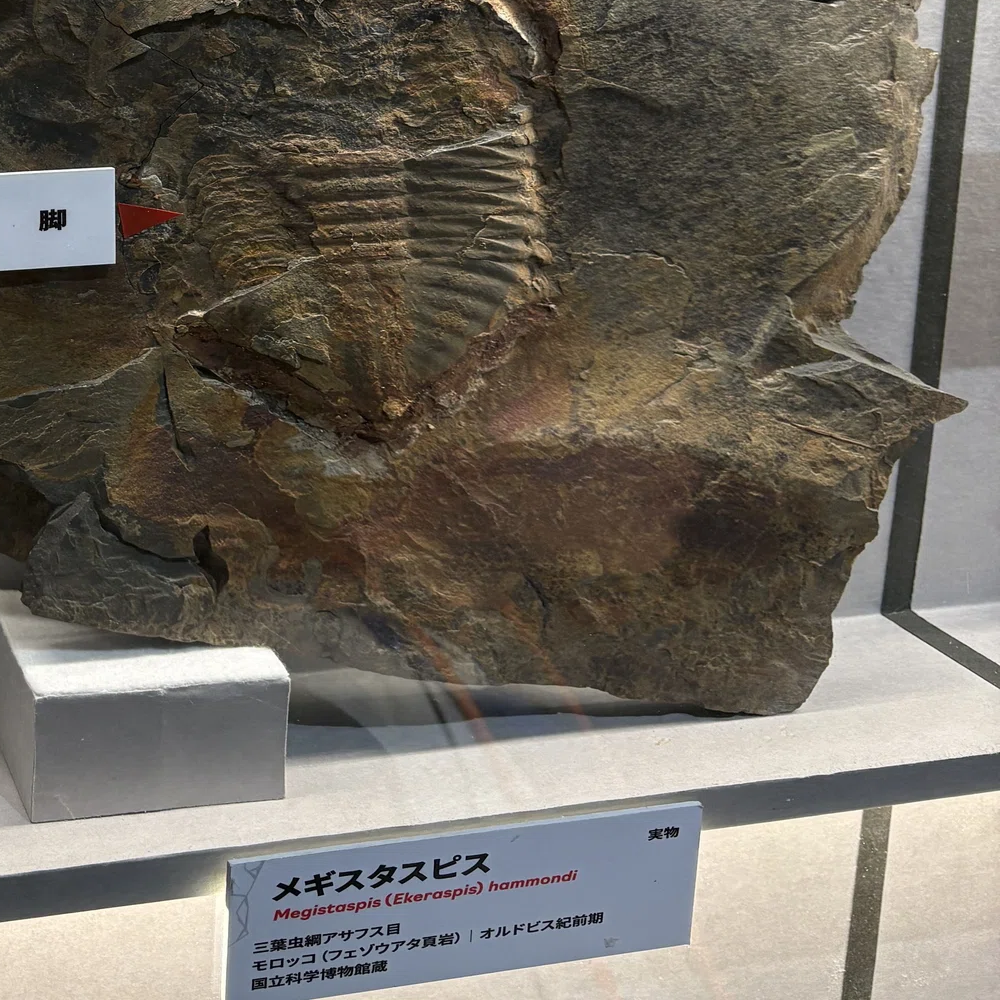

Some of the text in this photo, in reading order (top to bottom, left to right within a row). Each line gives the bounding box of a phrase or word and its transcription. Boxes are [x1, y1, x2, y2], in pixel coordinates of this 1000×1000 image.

[39, 208, 67, 231] 脚
[648, 826, 680, 841] 実物
[272, 852, 491, 903] メギスタスピス
[272, 869, 579, 922] Megistaspis (Ekeraspis) hammondi
[253, 923, 402, 955] 三葉虫綱アサフス目
[479, 911, 605, 941] オルドビス紀前期
[251, 960, 389, 991] 国立科学博物館蔵
